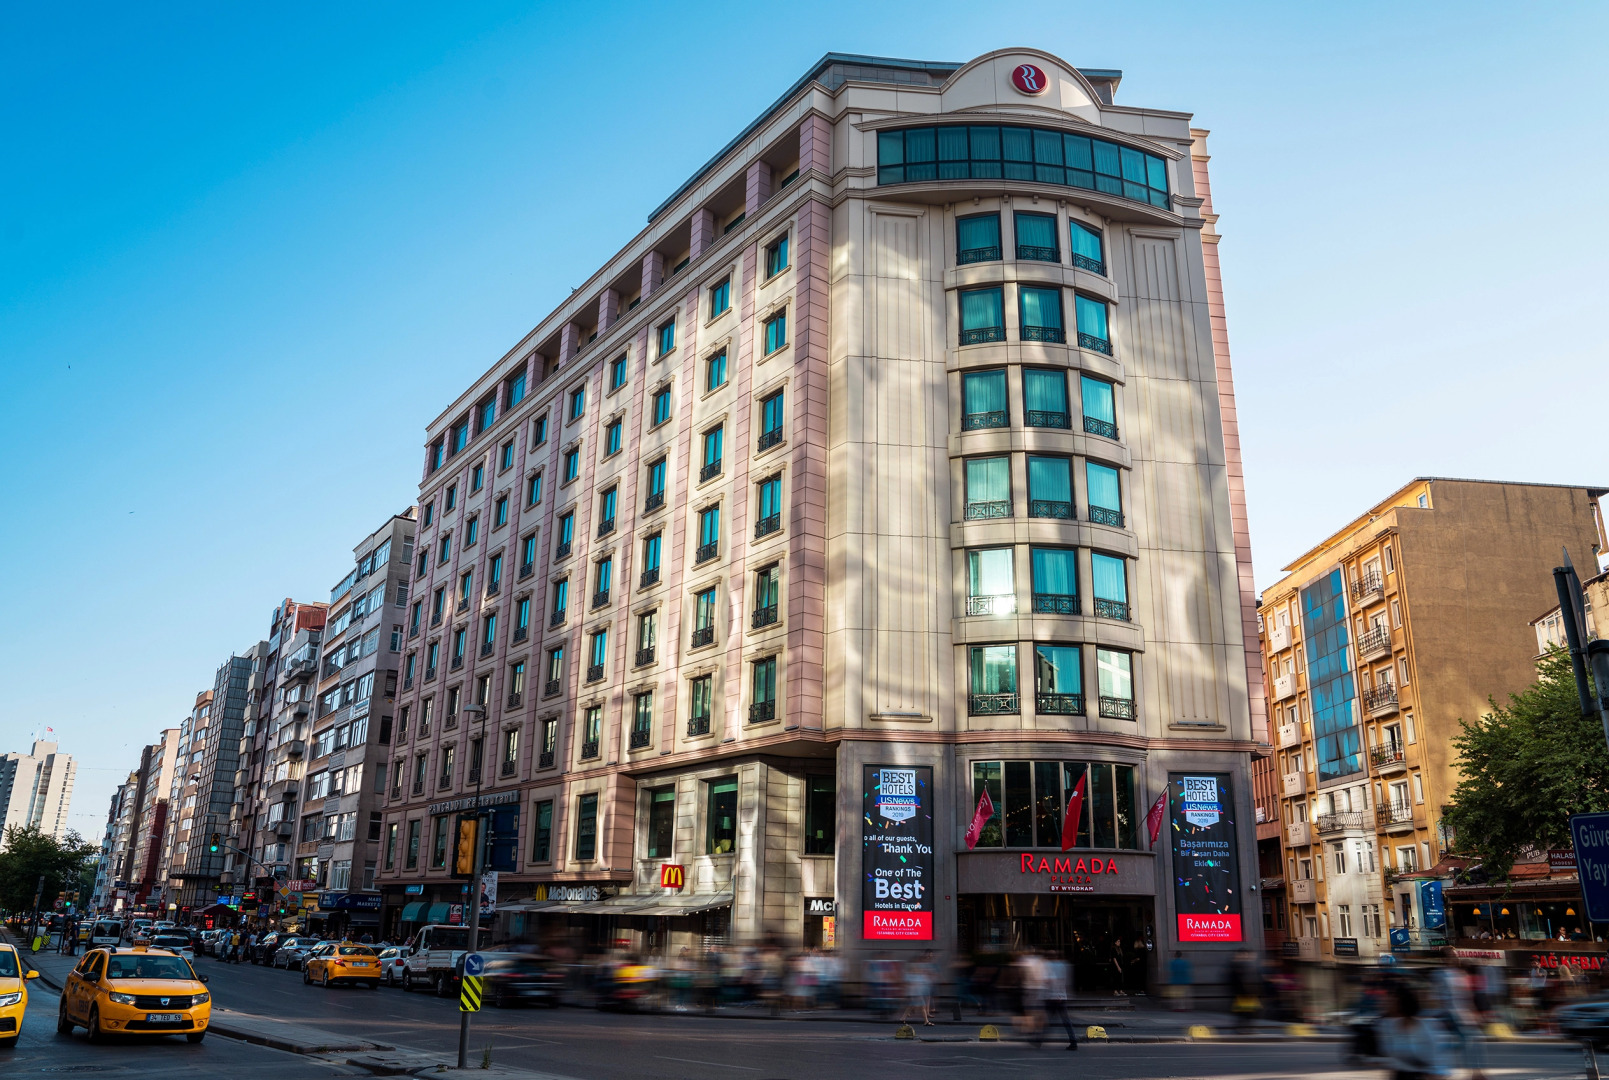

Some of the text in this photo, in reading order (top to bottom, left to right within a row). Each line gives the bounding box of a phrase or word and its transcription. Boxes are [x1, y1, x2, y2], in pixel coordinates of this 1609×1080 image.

[882, 772, 914, 783] BEST
[881, 784, 914, 794] HOTELS
[1186, 780, 1214, 790] BEST
[1186, 791, 1216, 801] HOTELS
[882, 843, 913, 854] Thank
[1180, 839, 1229, 849] Başarımıza
[1021, 853, 1119, 874] RAMADA
[875, 868, 922, 877] One of The
[1582, 857, 1609, 887] Yay
[1051, 875, 1092, 883] PLAZA
[548, 885, 598, 901] McDonald's
[875, 878, 922, 899] Best
[810, 900, 835, 911] Mc
[873, 915, 922, 927] RAMADA
[1186, 918, 1232, 929] RAMADA
[1531, 952, 1558, 969] AĞ
